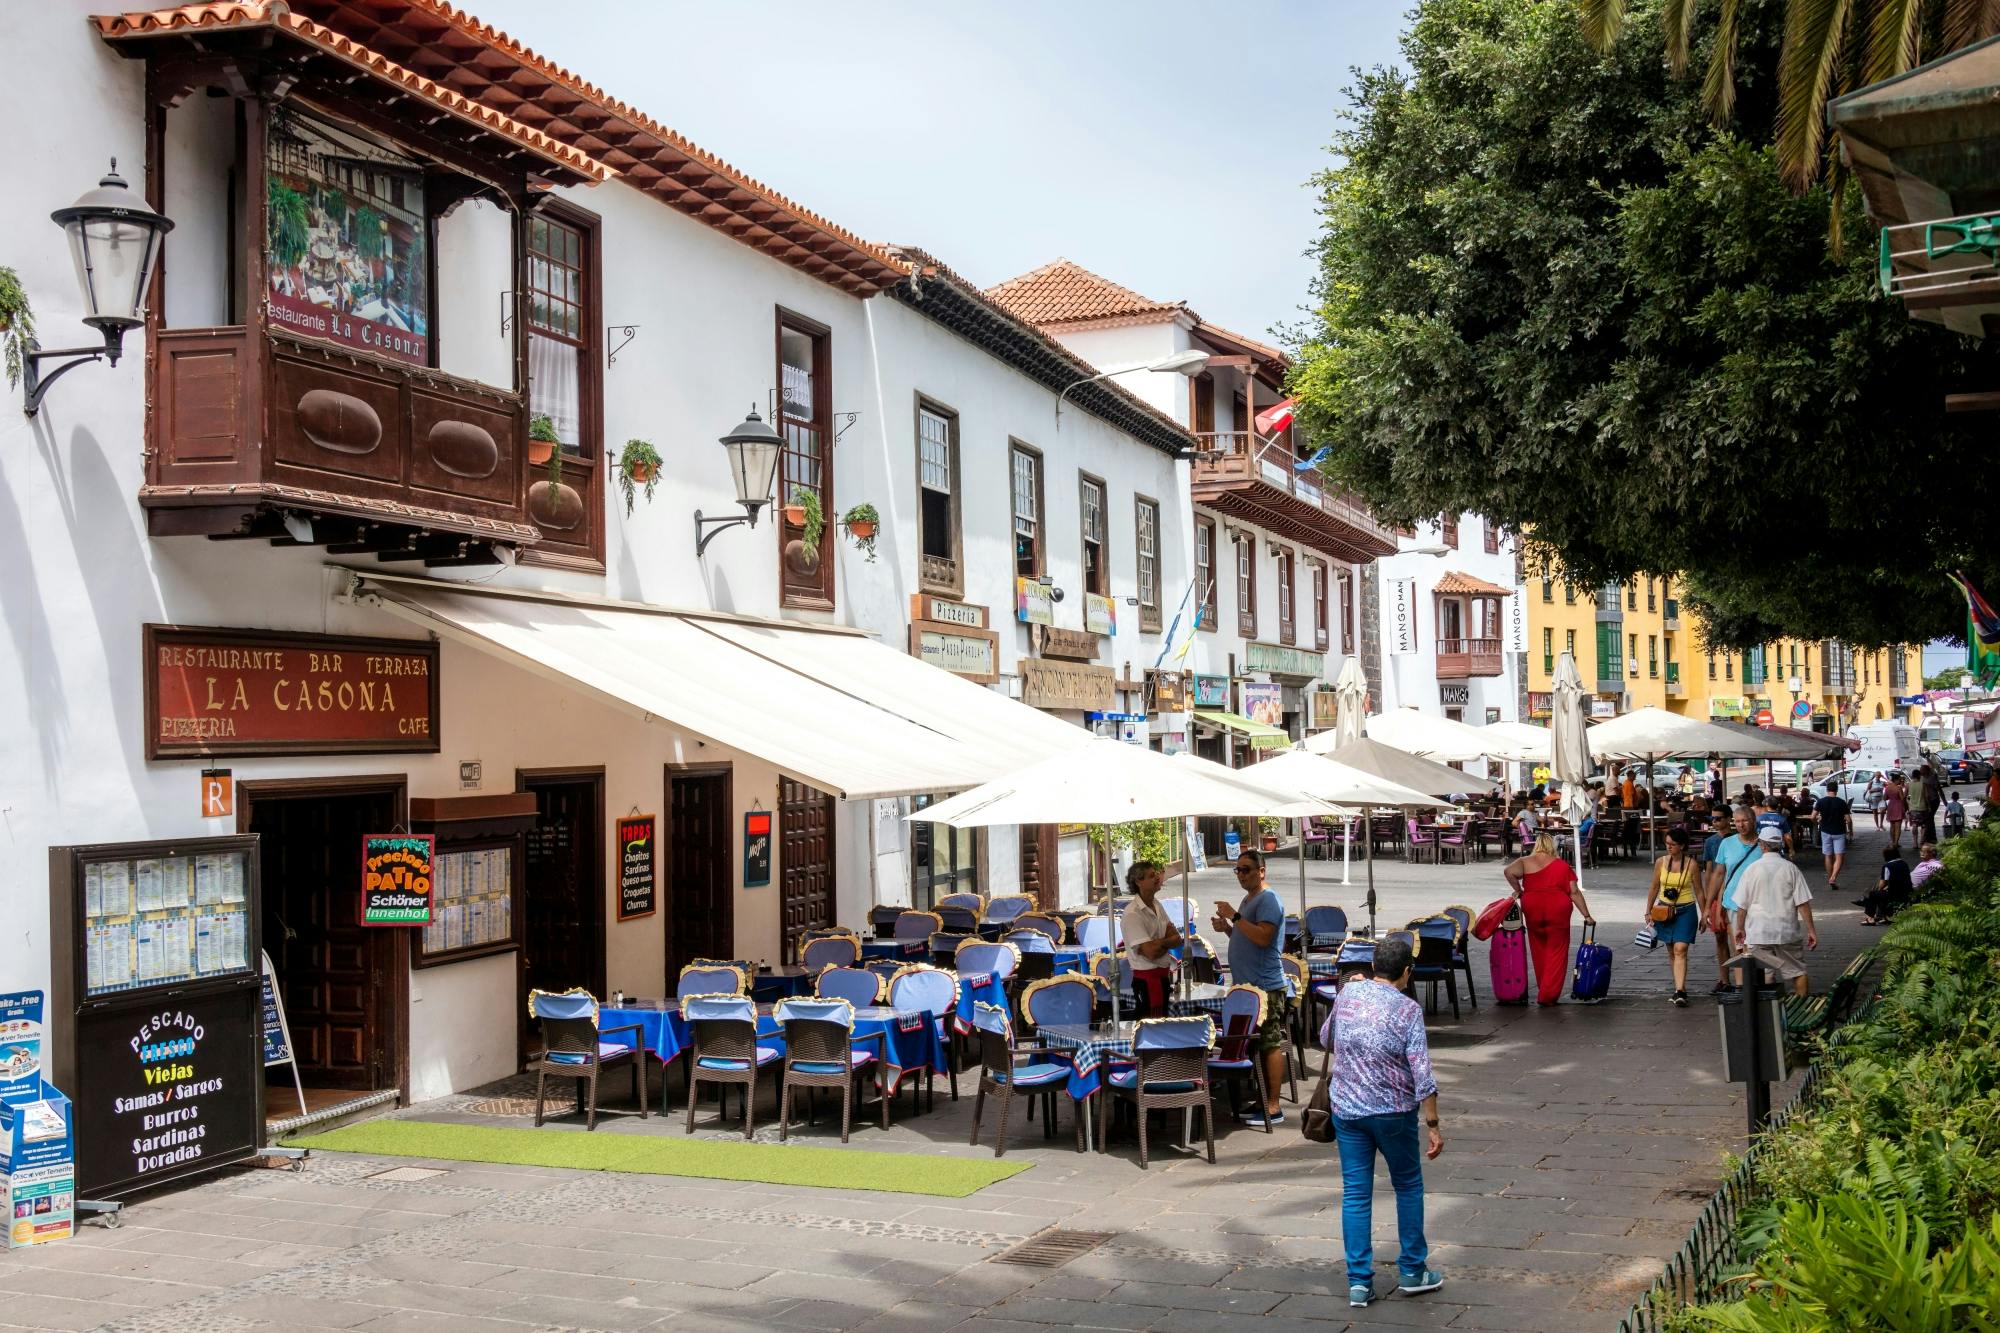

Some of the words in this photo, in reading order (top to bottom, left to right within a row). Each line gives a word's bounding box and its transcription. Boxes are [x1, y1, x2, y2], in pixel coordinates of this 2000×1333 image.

[267, 304, 326, 331] estaurante
[331, 313, 351, 339] La
[362, 325, 420, 358] Casona
[1397, 603, 1408, 651] MANGO
[160, 647, 284, 672] RESTAURANTE
[310, 653, 342, 673] BAR
[366, 657, 429, 677] TERRAZA
[206, 677, 249, 711] LA
[273, 678, 396, 713] CASONA
[1443, 687, 1468, 703] MANGO
[160, 716, 237, 738] PIZZERIA
[399, 717, 430, 735] CAFE
[209, 782, 225, 813] R
[622, 825, 651, 841] TAPAS
[749, 836, 766, 859] Mojito
[367, 848, 430, 874] Precioso
[625, 863, 650, 876] Sardinas
[367, 866, 430, 894] PATIO
[622, 876, 639, 888] Queso
[624, 886, 650, 898] Croquetas
[370, 894, 427, 907] Schöner
[627, 900, 648, 911] Churros
[366, 907, 429, 919] Innenhof
[0, 998, 14, 1008] ake
[21, 996, 39, 1006] Free
[17, 1032, 41, 1040] Tenerife
[130, 1011, 205, 1054] PESCADO
[140, 1036, 195, 1064] FRESCO
[144, 1063, 194, 1086] Viejas
[114, 1091, 164, 1114] Samas
[175, 1076, 223, 1100] Sargos
[144, 1104, 198, 1131] Burros
[132, 1123, 206, 1154] Sardinas
[138, 1144, 202, 1173] Doradas
